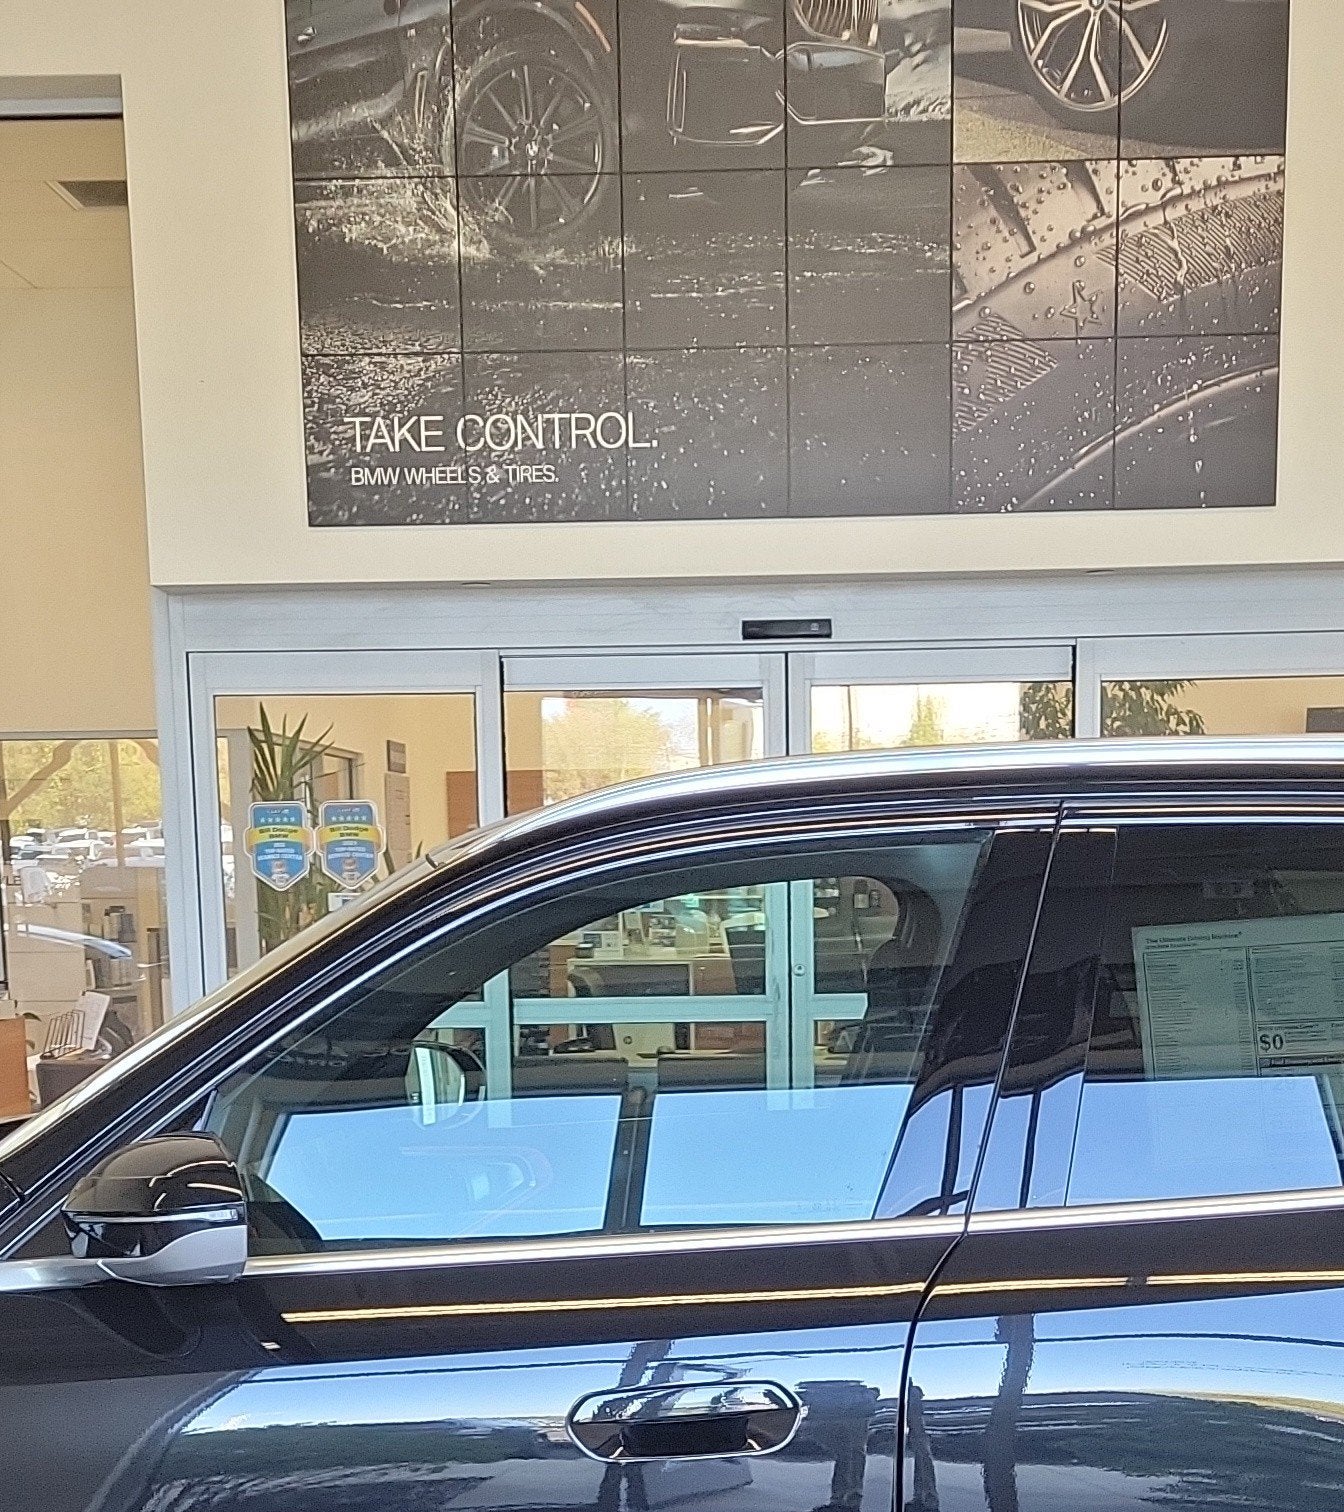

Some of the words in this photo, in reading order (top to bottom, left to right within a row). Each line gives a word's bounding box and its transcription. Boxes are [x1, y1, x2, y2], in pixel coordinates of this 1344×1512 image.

[343, 414, 445, 452] TAKE
[456, 411, 658, 451] CONTROL.
[351, 467, 400, 486] BMW
[404, 466, 483, 485] WHEELS
[486, 466, 500, 484] &
[506, 465, 559, 484] TIRES.
[1259, 1033, 1284, 1053] $0
